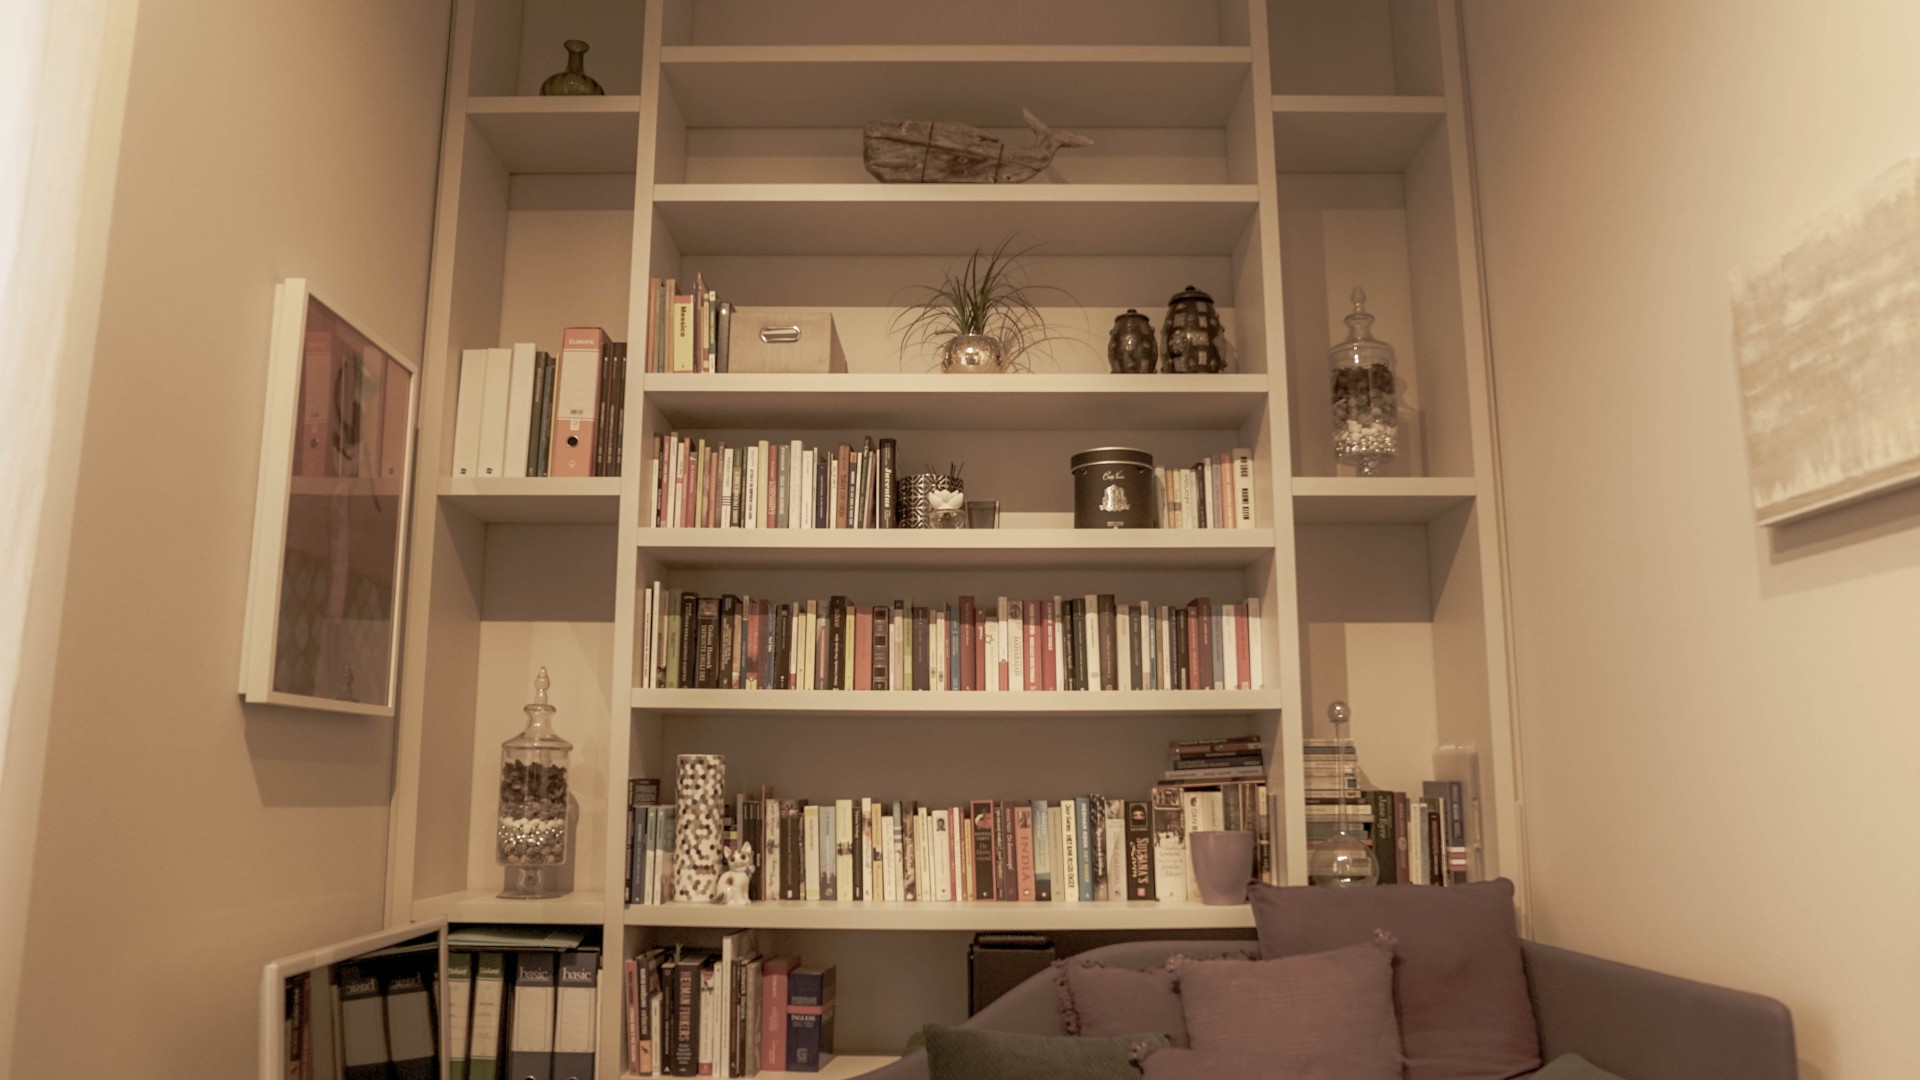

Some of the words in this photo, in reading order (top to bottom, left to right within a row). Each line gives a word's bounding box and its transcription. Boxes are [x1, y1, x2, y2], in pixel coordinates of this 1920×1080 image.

[1240, 465, 1248, 477] LOGO
[883, 467, 892, 508] Juventus
[1378, 795, 1388, 819] Jane
[1377, 819, 1387, 839] Eyre
[1020, 836, 1031, 882] INDIA
[1136, 837, 1150, 884] SULTANA'S
[519, 965, 549, 979] basic
[562, 966, 592, 980] basic
[679, 970, 691, 1005] HERMAN
[678, 1006, 691, 1041] FINKERS
